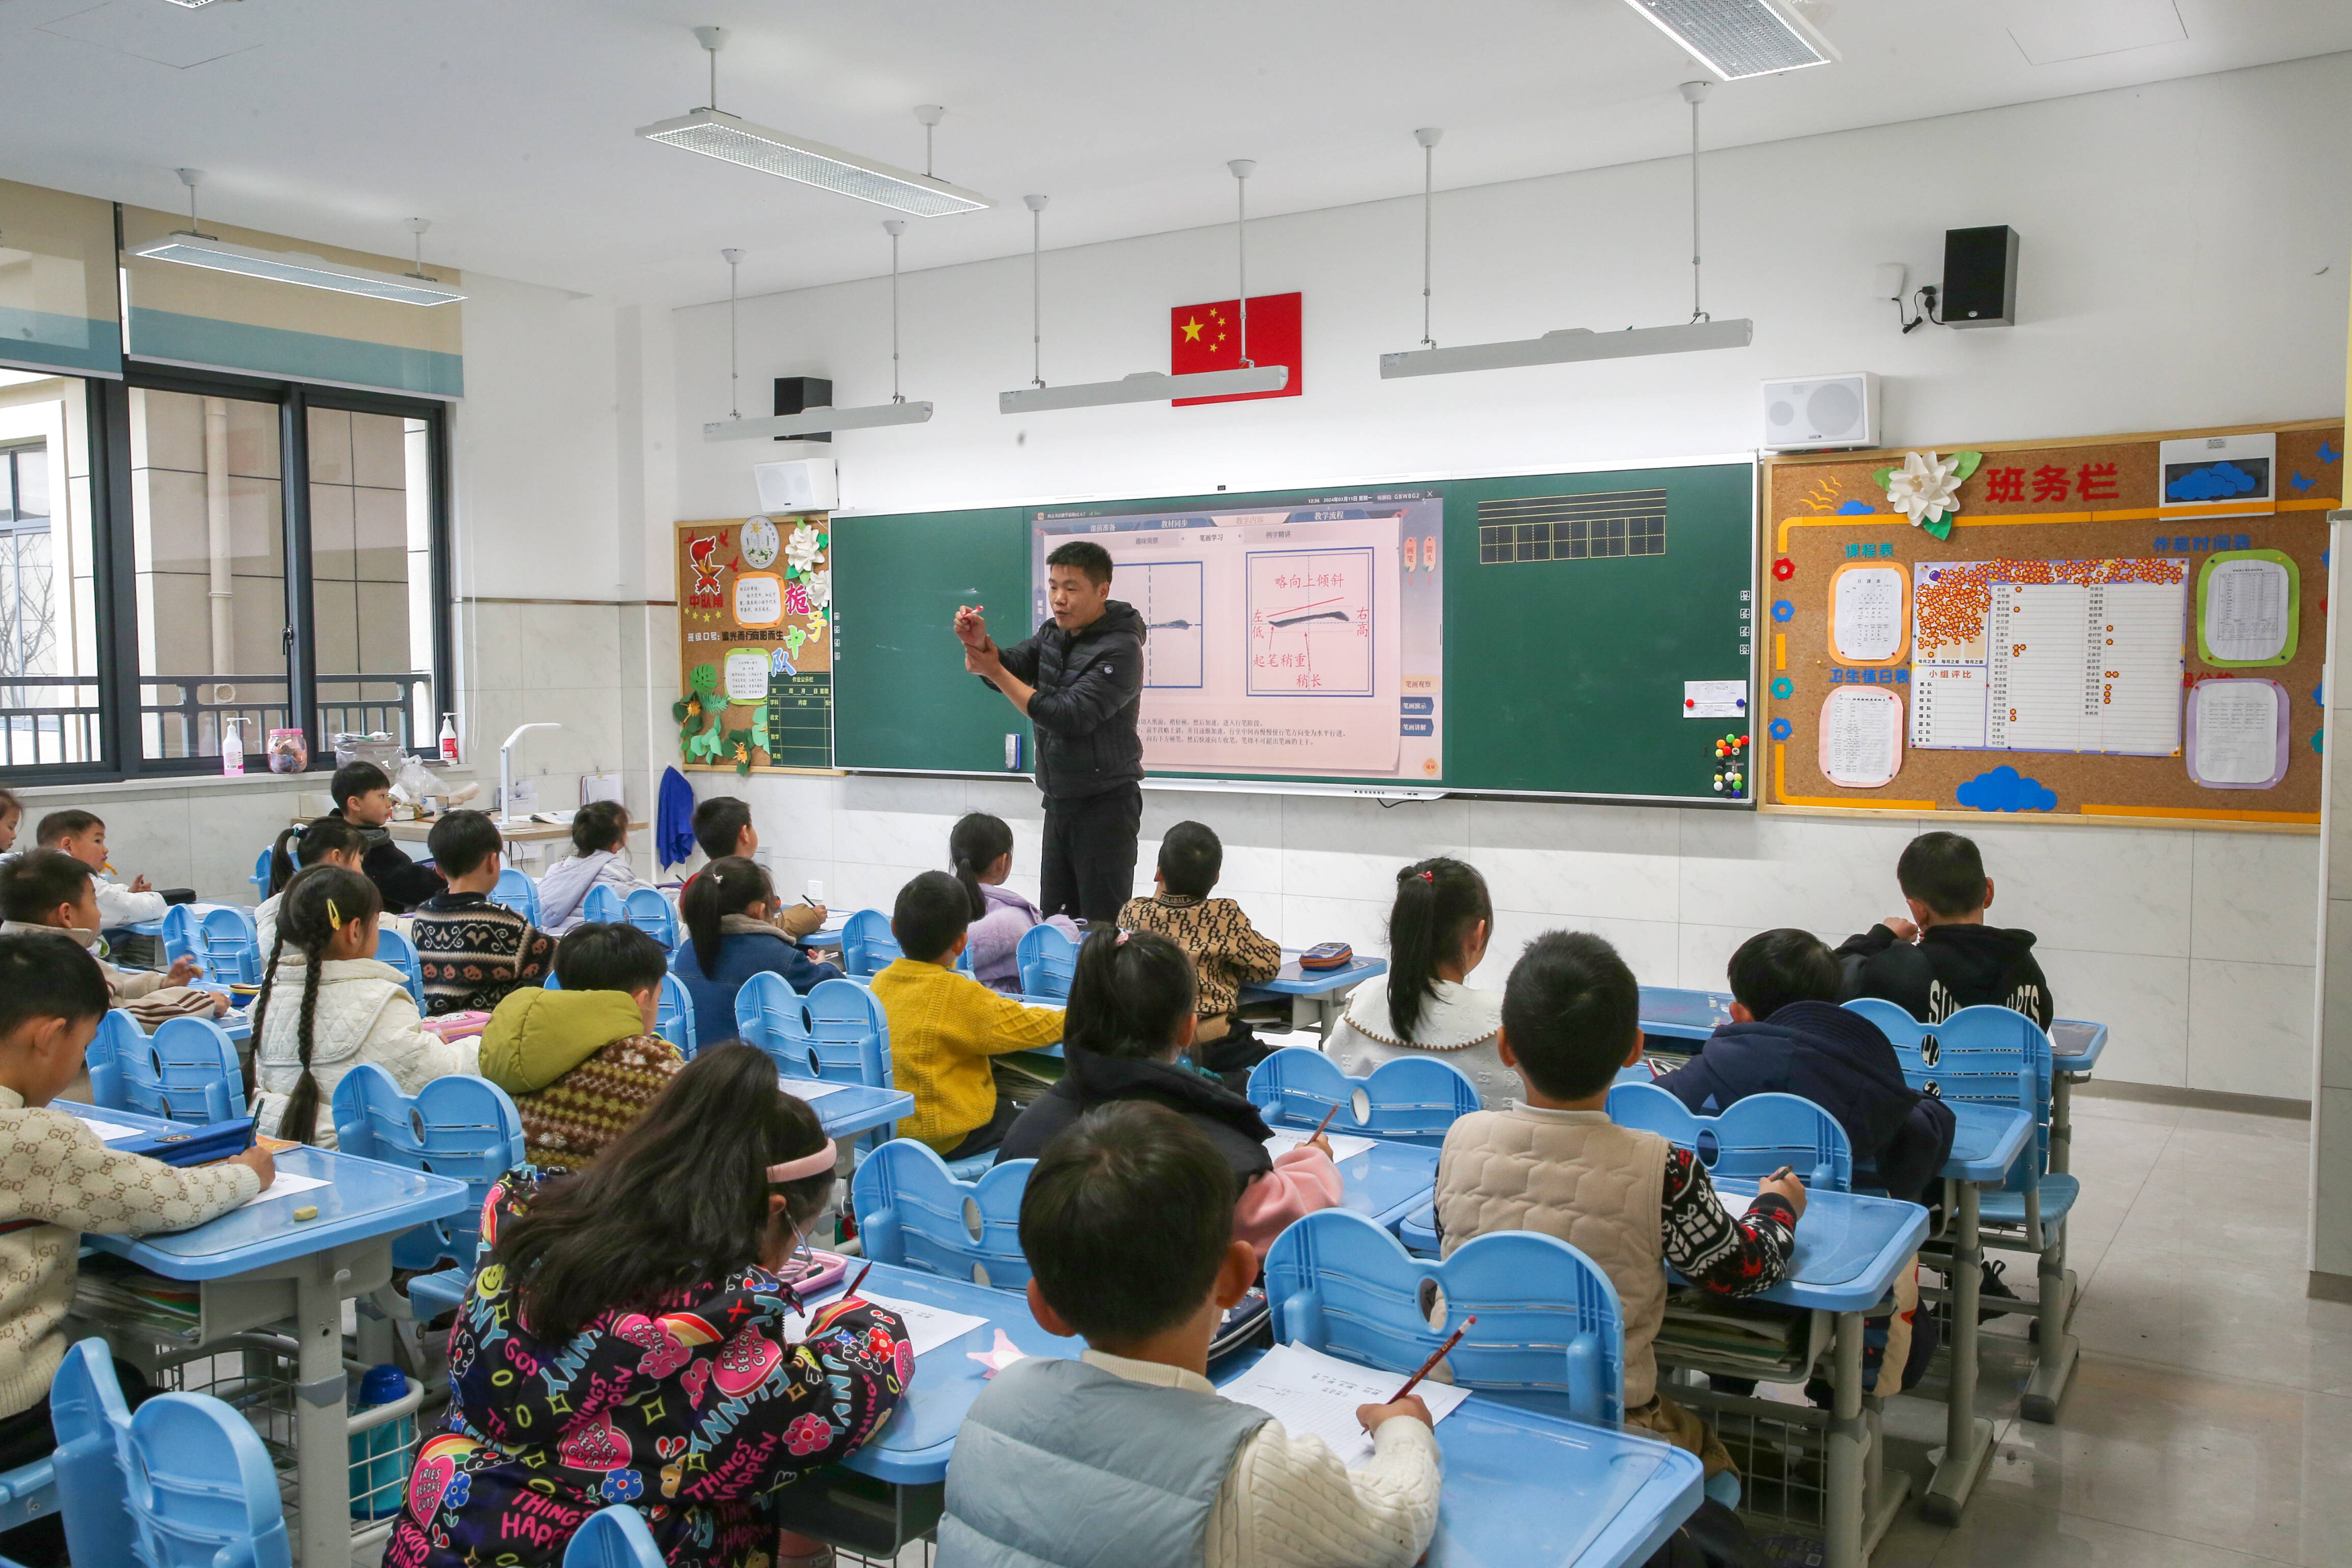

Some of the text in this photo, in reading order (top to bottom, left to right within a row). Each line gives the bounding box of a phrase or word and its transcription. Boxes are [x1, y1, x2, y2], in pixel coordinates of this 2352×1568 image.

[1985, 462, 2120, 503] 班务栏
[1323, 495, 1358, 503] 2024年03月11日
[1161, 518, 1188, 528] 教材同步
[1236, 517, 1264, 525] 教学内容
[1314, 511, 1344, 520] 教学流程
[1090, 524, 1116, 532] 课前准备
[1266, 531, 1291, 539] 例字精讲
[1845, 543, 1894, 558] 课程表
[2153, 534, 2251, 552] 作息时间表
[1407, 546, 1414, 564] 画笔
[1275, 573, 1344, 589] 略向上倾斜
[1252, 609, 1264, 639] 左低
[1356, 606, 1369, 638] 右高
[722, 630, 784, 641] 追光而行向阳而生
[1253, 653, 1307, 668] 起笔稍重
[1296, 674, 1322, 688] 稍长
[1829, 668, 1909, 683] 卫生值日表
[1929, 670, 1972, 678] 小组评比
[419, 1467, 441, 1482] FRIES
[683, 1438, 751, 1501] THINGS
[416, 1482, 441, 1498] BEFORE
[417, 1497, 435, 1512] GUYS
